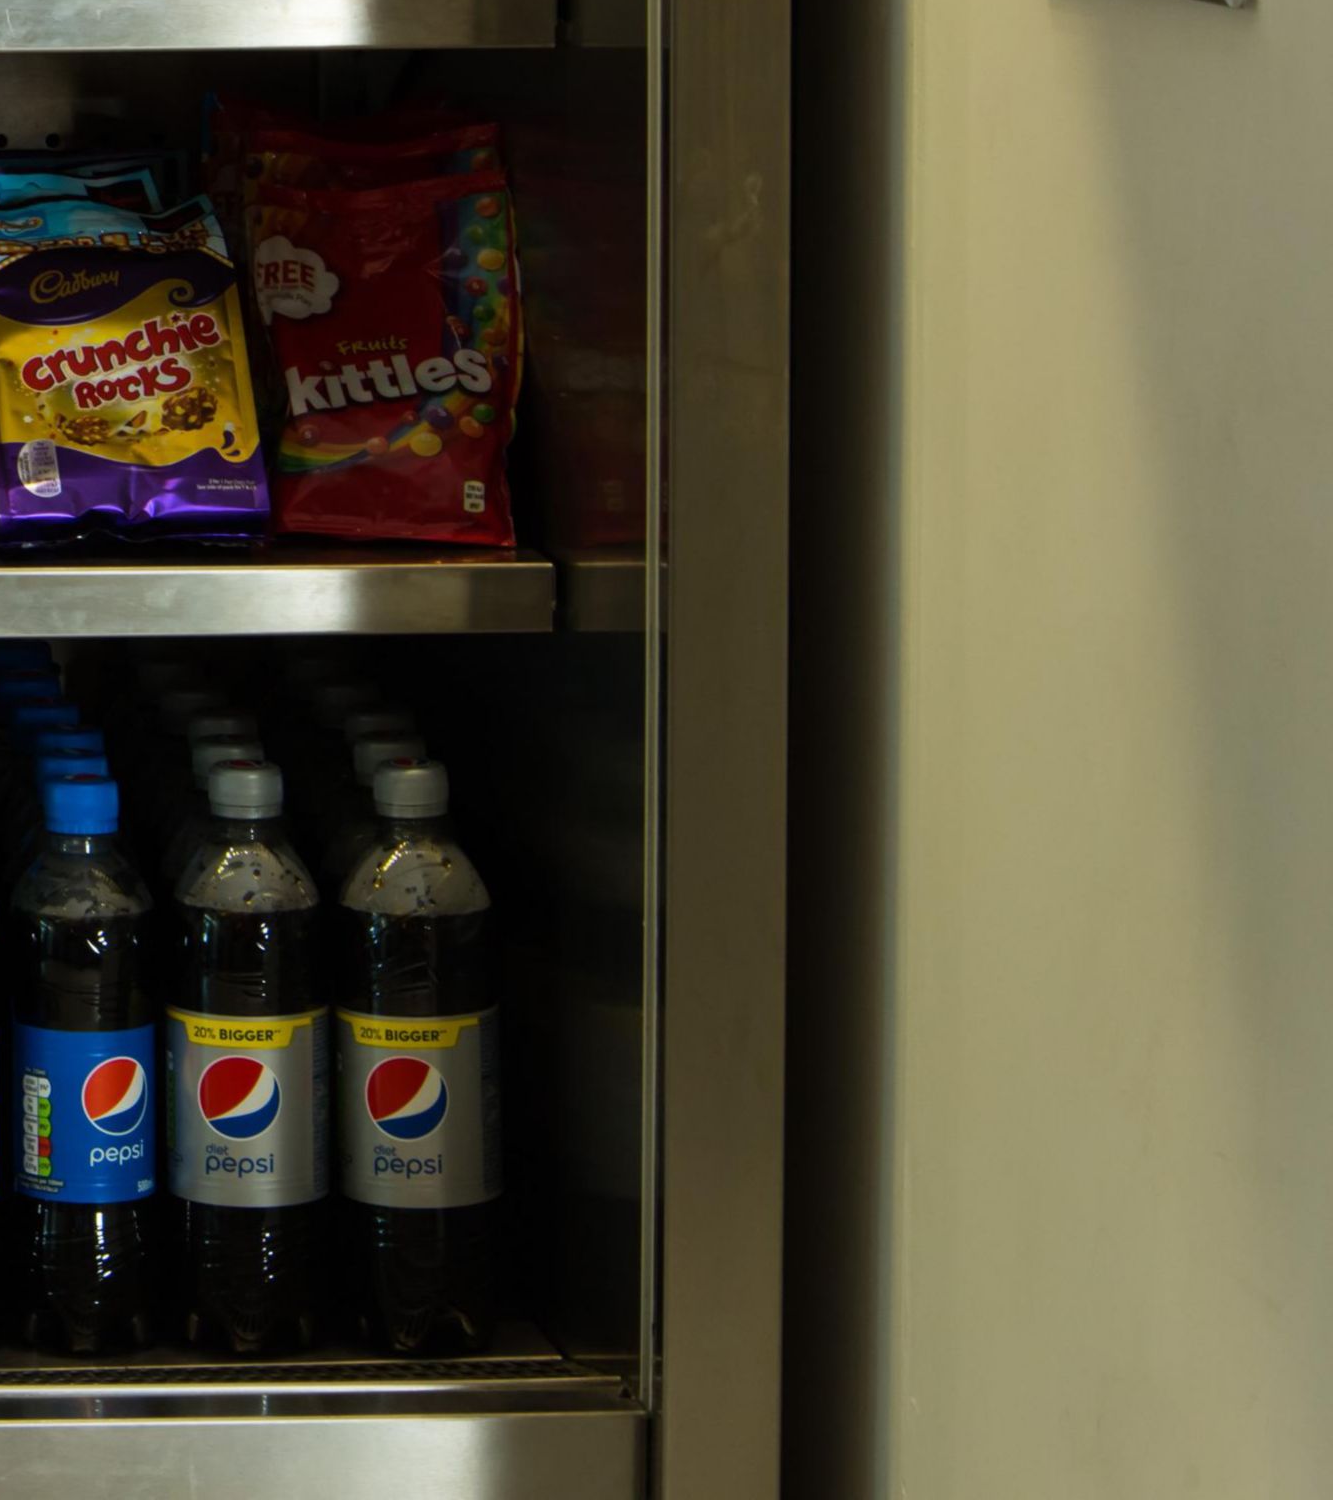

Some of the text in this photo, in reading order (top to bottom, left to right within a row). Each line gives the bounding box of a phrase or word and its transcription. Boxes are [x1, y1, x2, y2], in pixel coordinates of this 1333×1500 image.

[29, 269, 121, 304] Cadbury
[335, 334, 409, 356] Fruits
[192, 1026, 217, 1041] 20%
[359, 1026, 383, 1042] 20%
[89, 1138, 144, 1167] pepsi
[204, 1142, 229, 1156] diet
[372, 1144, 398, 1157] diet
[204, 1152, 276, 1179] pepsi
[373, 1154, 444, 1179] pepsi
